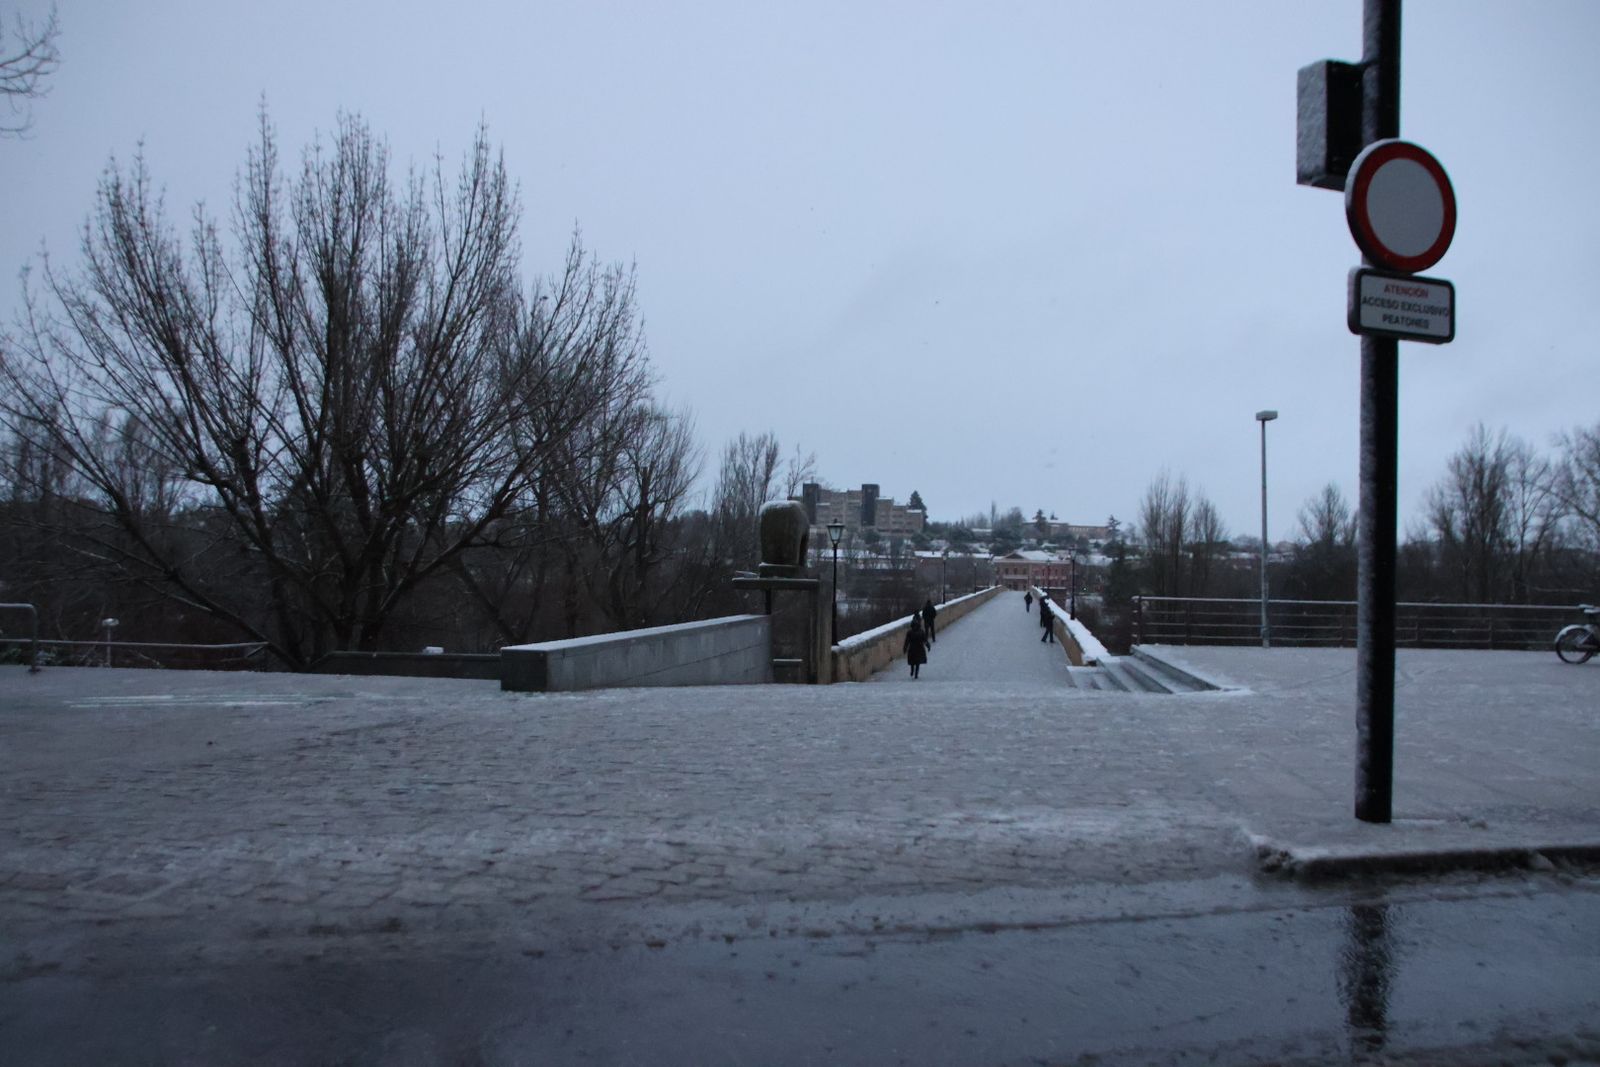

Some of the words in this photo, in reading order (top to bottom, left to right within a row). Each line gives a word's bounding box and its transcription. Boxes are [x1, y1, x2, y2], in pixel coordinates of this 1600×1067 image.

[1362, 296, 1398, 310] ACCESO
[1401, 301, 1448, 317] EXCLUSIVO
[1382, 314, 1429, 329] PEATONES
